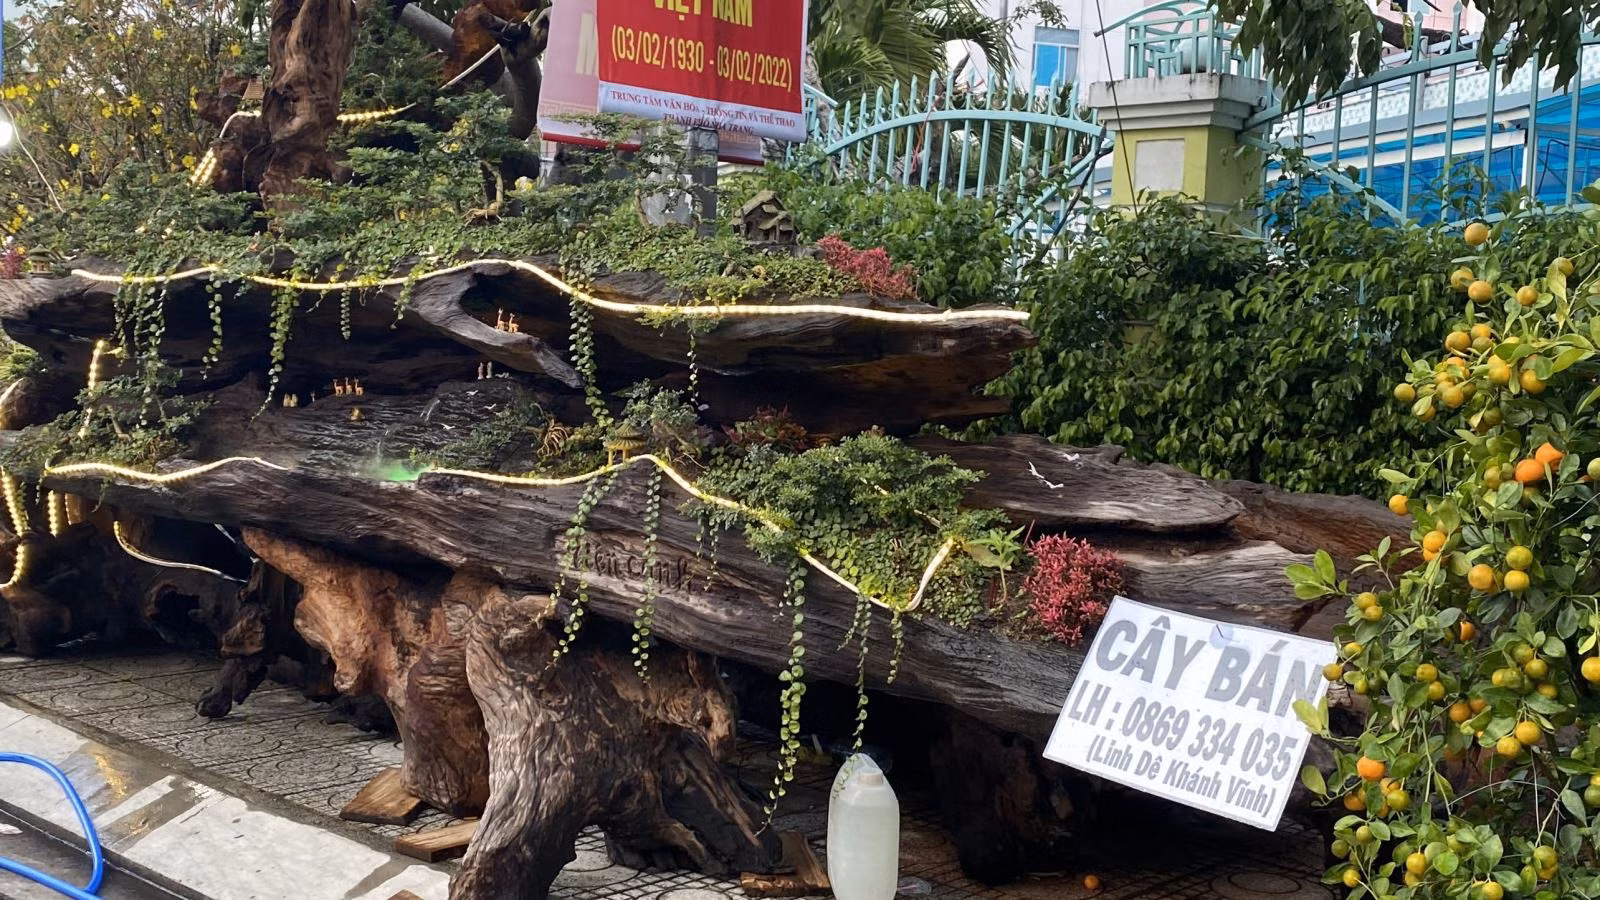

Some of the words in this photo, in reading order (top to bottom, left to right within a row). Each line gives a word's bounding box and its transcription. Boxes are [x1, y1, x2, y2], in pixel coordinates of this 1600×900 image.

[611, 25, 704, 73] (03/02/1930
[717, 45, 792, 93] 03/02/2022)
[611, 91, 641, 103] TRUNG
[643, 94, 661, 107] TÂM
[663, 98, 682, 109] VĂN
[706, 104, 734, 118] THÔNG
[735, 111, 747, 119] TIN
[749, 111, 758, 122] VÀ
[760, 113, 775, 125] THỂ
[775, 117, 796, 128] THAO
[1096, 615, 1207, 690] CÂY
[1204, 639, 1323, 717] BÁN
[1068, 680, 1112, 726] LH
[1121, 696, 1190, 751] 0869
[1187, 714, 1242, 765] 334
[1240, 728, 1298, 781] 035
[1086, 735, 1132, 772] (Linh
[1134, 744, 1162, 780] Dê
[1162, 758, 1222, 799] Khánh
[1225, 776, 1277, 818] Vĩnh)
